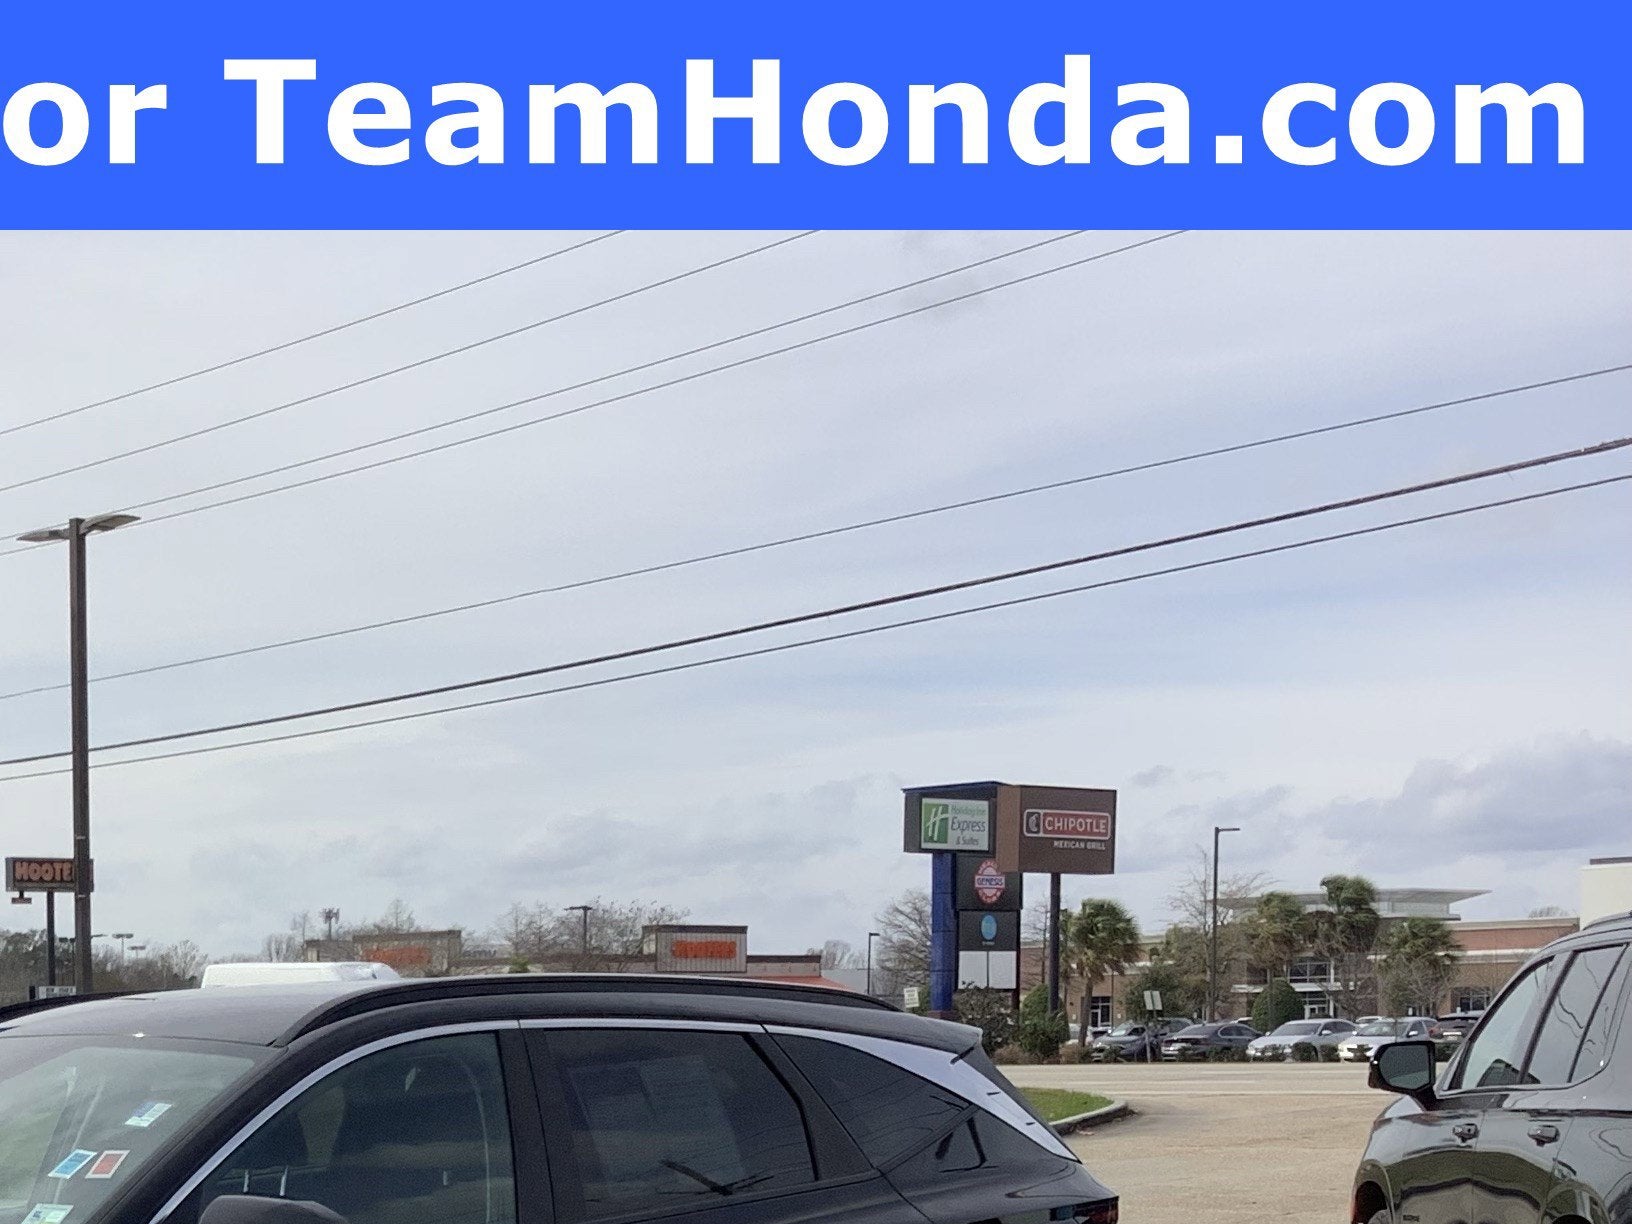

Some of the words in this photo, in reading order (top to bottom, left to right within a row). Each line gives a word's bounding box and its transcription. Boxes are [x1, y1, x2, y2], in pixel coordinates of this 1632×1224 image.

[951, 816, 986, 835] Express
[1045, 816, 1107, 833] CHIPOTLE
[1053, 840, 1085, 850] MEXICAN
[1086, 841, 1106, 851] GRILL
